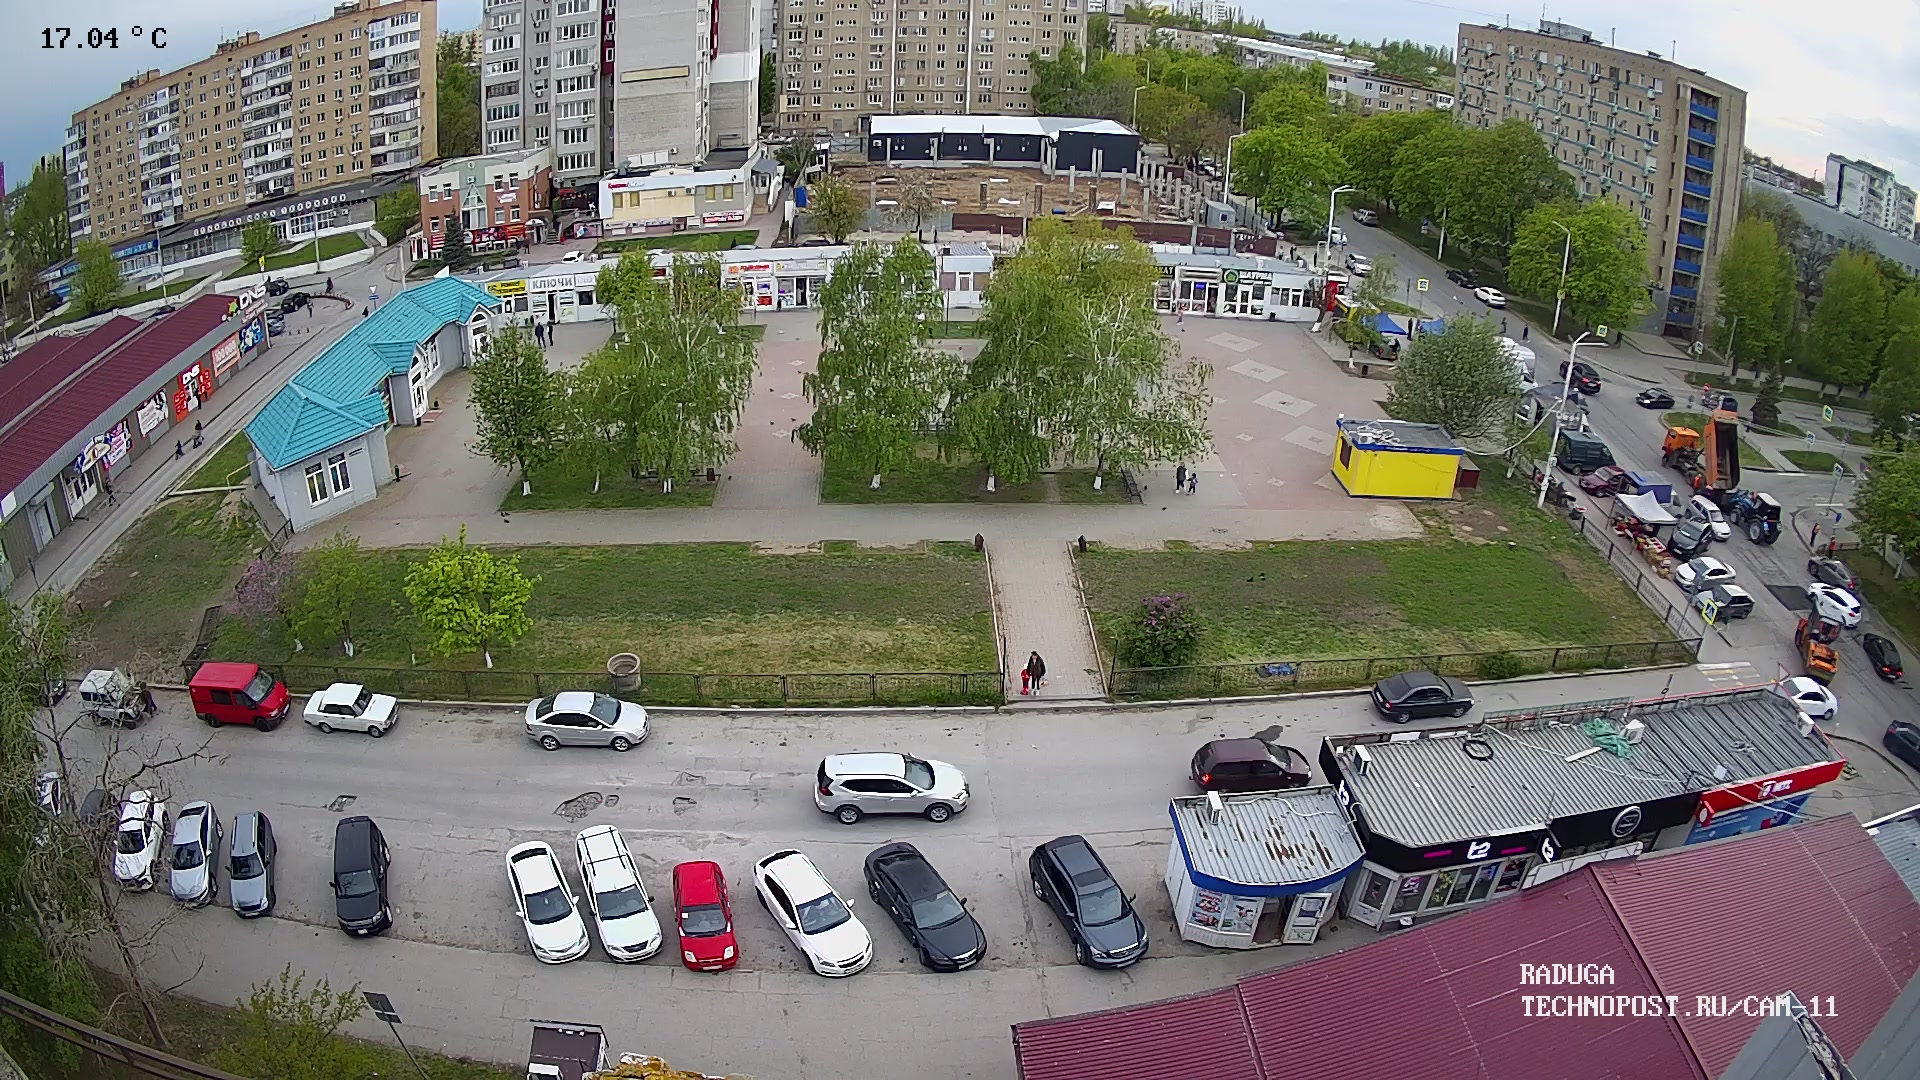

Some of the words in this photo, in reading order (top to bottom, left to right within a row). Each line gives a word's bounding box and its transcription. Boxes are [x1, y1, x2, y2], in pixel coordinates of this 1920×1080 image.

[533, 277, 573, 289] КЛЮЧИ
[240, 286, 266, 309] DNS
[183, 364, 200, 384] DNS
